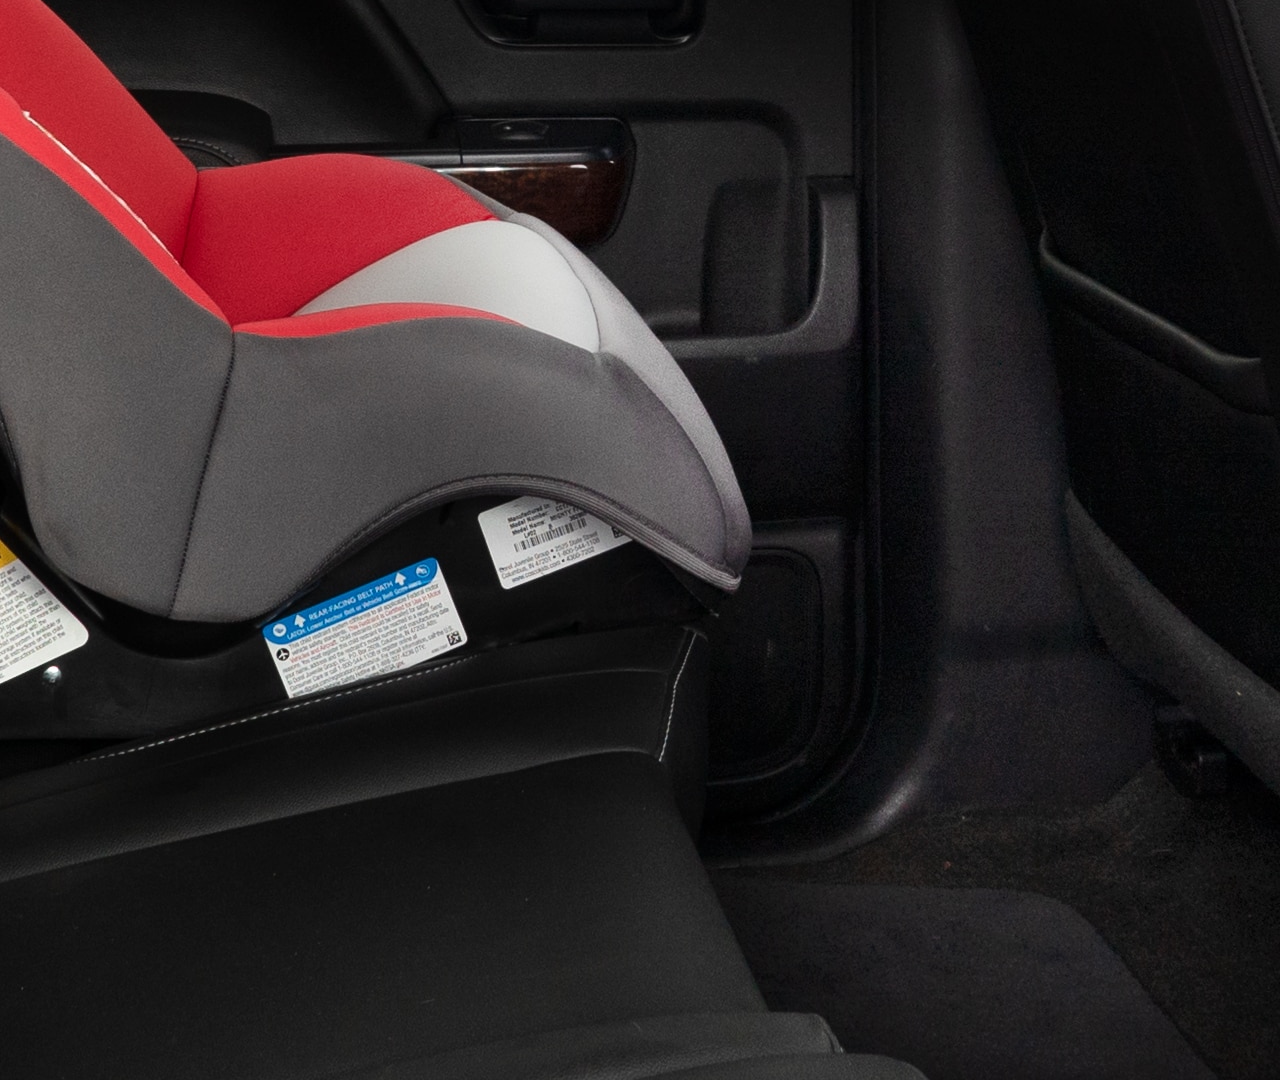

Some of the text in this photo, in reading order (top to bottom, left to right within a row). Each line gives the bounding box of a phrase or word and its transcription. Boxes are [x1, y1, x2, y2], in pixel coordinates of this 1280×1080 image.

[308, 596, 357, 621] REAR-FACING
[357, 588, 375, 601] BELT
[374, 581, 394, 593] PATH
